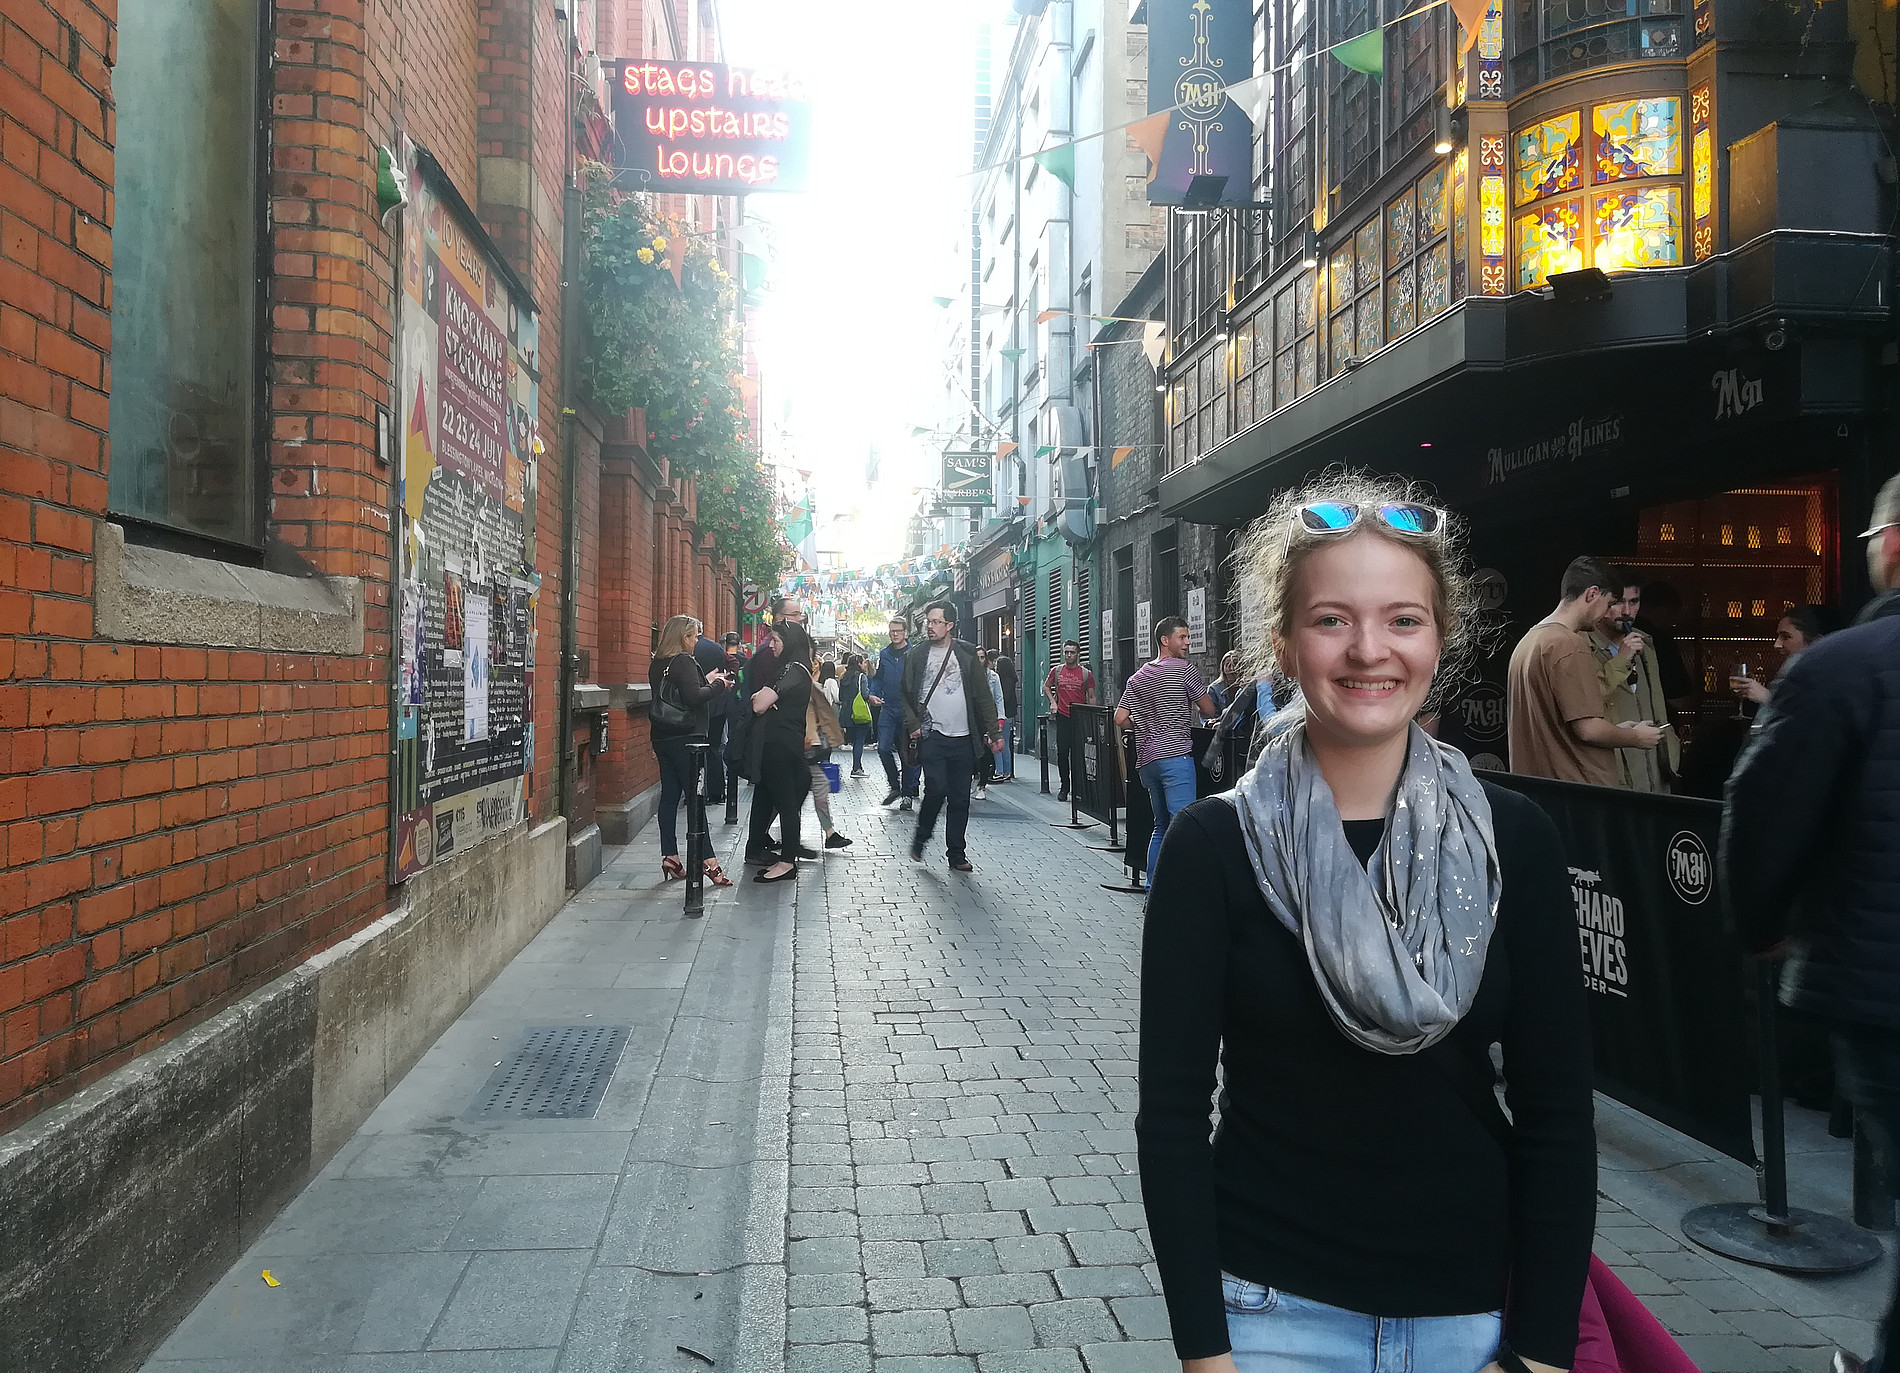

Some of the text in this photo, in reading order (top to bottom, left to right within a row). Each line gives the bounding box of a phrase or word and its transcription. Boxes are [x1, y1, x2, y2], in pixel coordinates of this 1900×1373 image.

[624, 62, 714, 101] stags
[454, 229, 482, 288] YEARS
[442, 400, 454, 436] 22
[456, 412, 468, 445] 23
[482, 433, 502, 469] JULY
[1487, 441, 1549, 485] MULLIGAN
[1568, 416, 1620, 462] HAINES
[947, 458, 986, 468] SAM'S
[1671, 847, 1706, 887] MH
